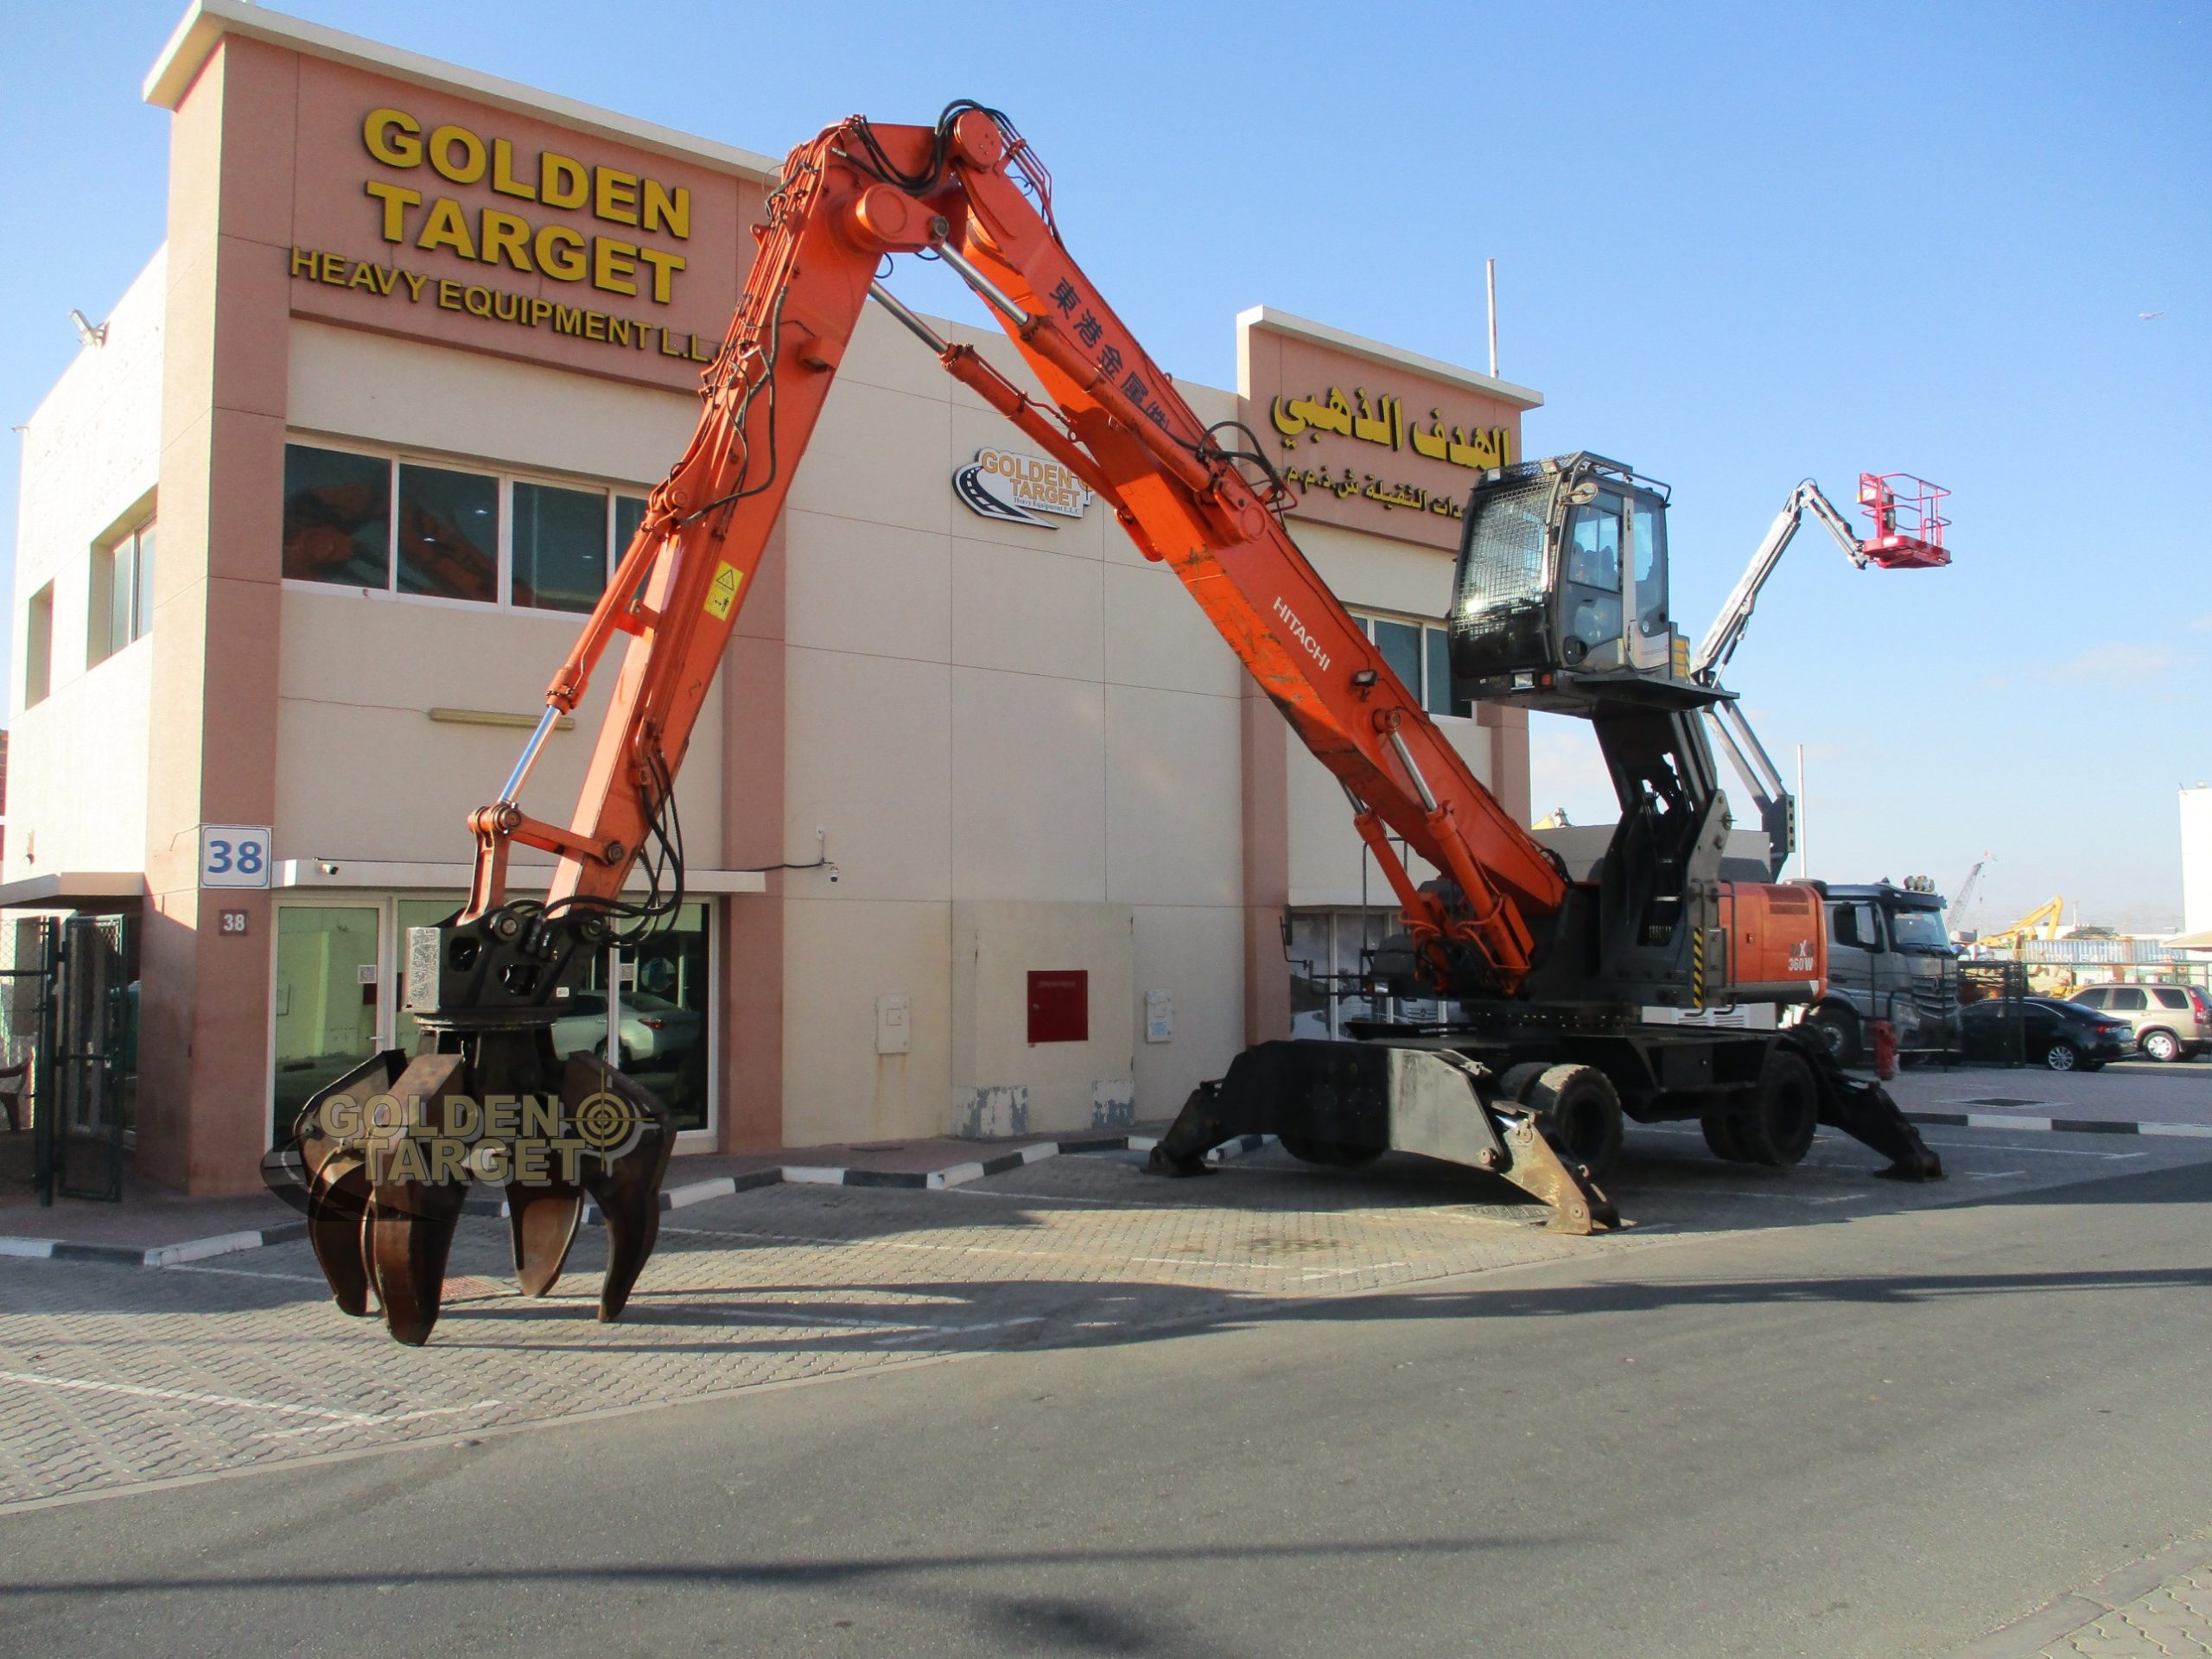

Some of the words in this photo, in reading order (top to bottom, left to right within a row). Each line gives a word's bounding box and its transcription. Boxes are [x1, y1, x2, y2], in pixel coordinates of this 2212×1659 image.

[362, 107, 690, 239] GOLDEN
[364, 179, 687, 305] TARGET
[290, 245, 429, 302] HEAVY
[438, 279, 654, 351] EQUIPMENT
[1270, 386, 1404, 452] الذهبي
[1411, 407, 1512, 471] الهدف
[981, 452, 1073, 490] GOLDEN
[1009, 478, 1080, 508] TARGET
[1362, 474, 1427, 512] الثقيلة
[1273, 596, 1331, 672] HITACHI
[207, 840, 263, 874] 38
[223, 913, 245, 931] 38
